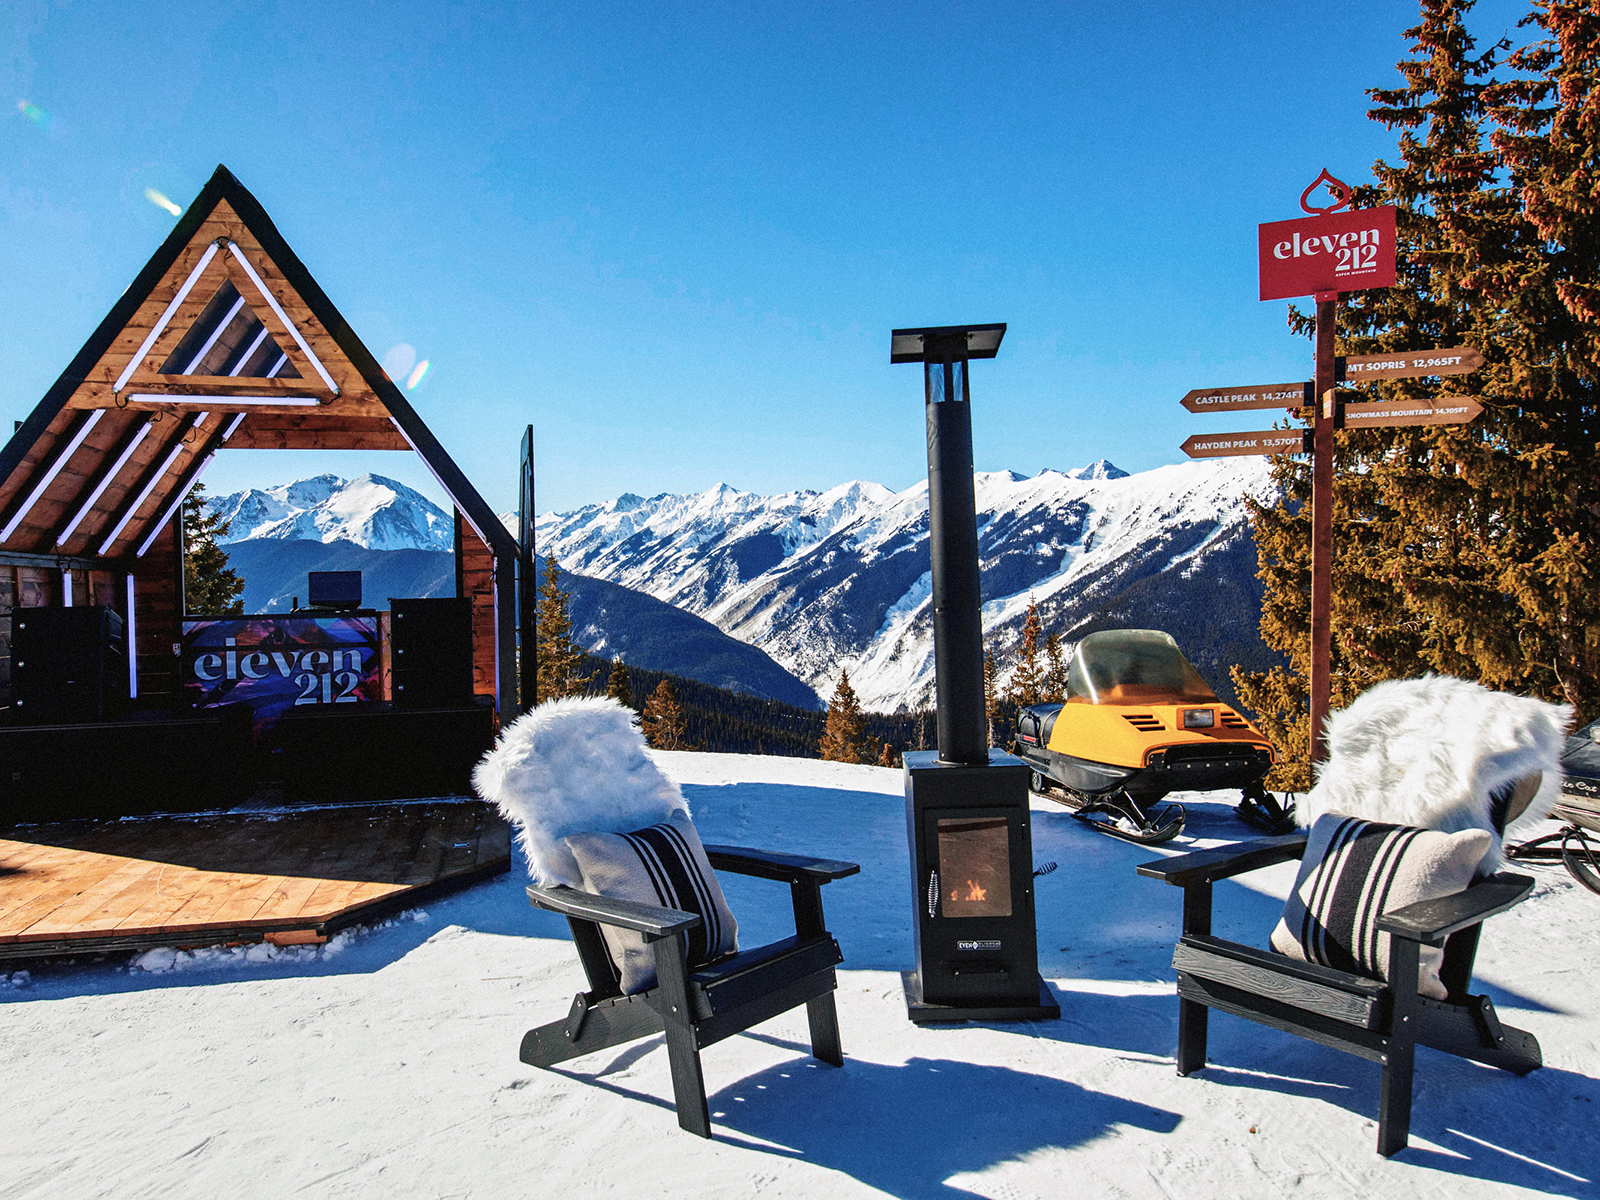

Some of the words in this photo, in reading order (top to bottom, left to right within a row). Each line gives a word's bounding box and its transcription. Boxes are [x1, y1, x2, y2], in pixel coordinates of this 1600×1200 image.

[1273, 228, 1380, 260] eleven
[1335, 244, 1378, 272] 212
[1351, 268, 1377, 276] MOUNTAIN
[1347, 363, 1364, 373] MT
[1365, 360, 1406, 371] SOPRIS
[1412, 356, 1462, 369] 12,965FT
[1195, 394, 1230, 405] CASTLE
[1231, 393, 1257, 403] PEAK
[1261, 390, 1304, 401] 14,274FT
[1346, 410, 1390, 420] SNOWMASS
[1391, 408, 1433, 417] MOUNTAIN
[1435, 406, 1469, 415] 14,105FT
[1194, 441, 1232, 451] HAYDEN
[1232, 439, 1258, 448] PEAK
[1262, 437, 1303, 447] 13,570FT
[194, 637, 362, 680] eleven
[294, 671, 359, 706] 212
[1575, 781, 1598, 792] Cat
